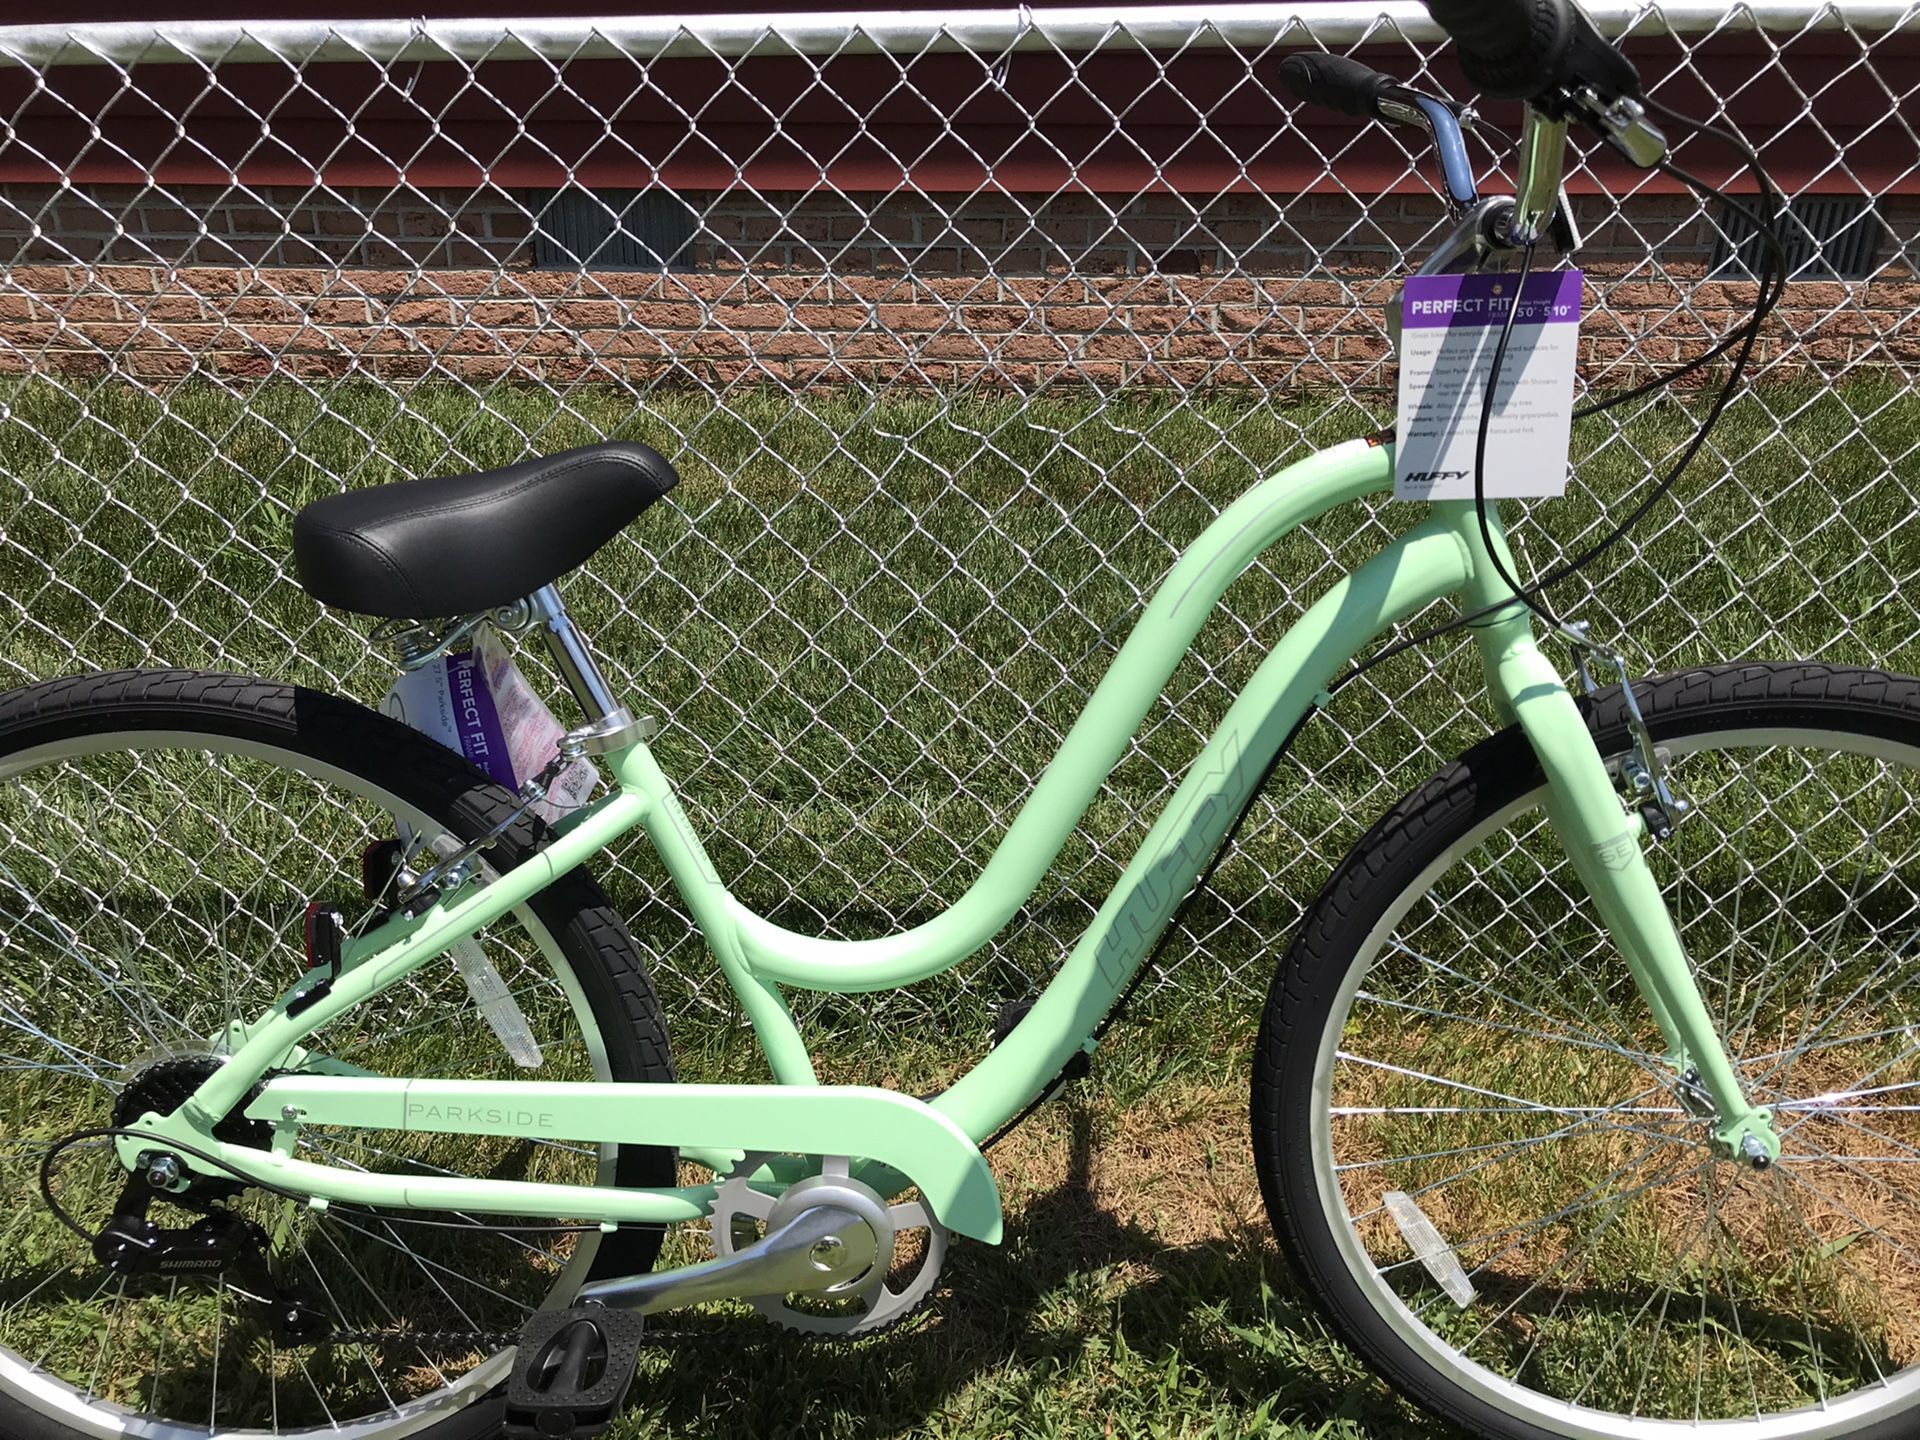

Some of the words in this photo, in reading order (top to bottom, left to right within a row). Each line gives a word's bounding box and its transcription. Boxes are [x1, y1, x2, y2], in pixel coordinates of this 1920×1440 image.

[1411, 299, 1484, 315] PERFECT
[1488, 297, 1513, 312] FIT
[1405, 470, 1471, 482] HUFFY
[457, 660, 481, 728] PERFECT
[471, 732, 489, 755] FIT
[1094, 729, 1245, 990] HUFFY
[408, 1103, 553, 1128] PARKSIDE
[159, 1259, 222, 1269] SHIMANO
